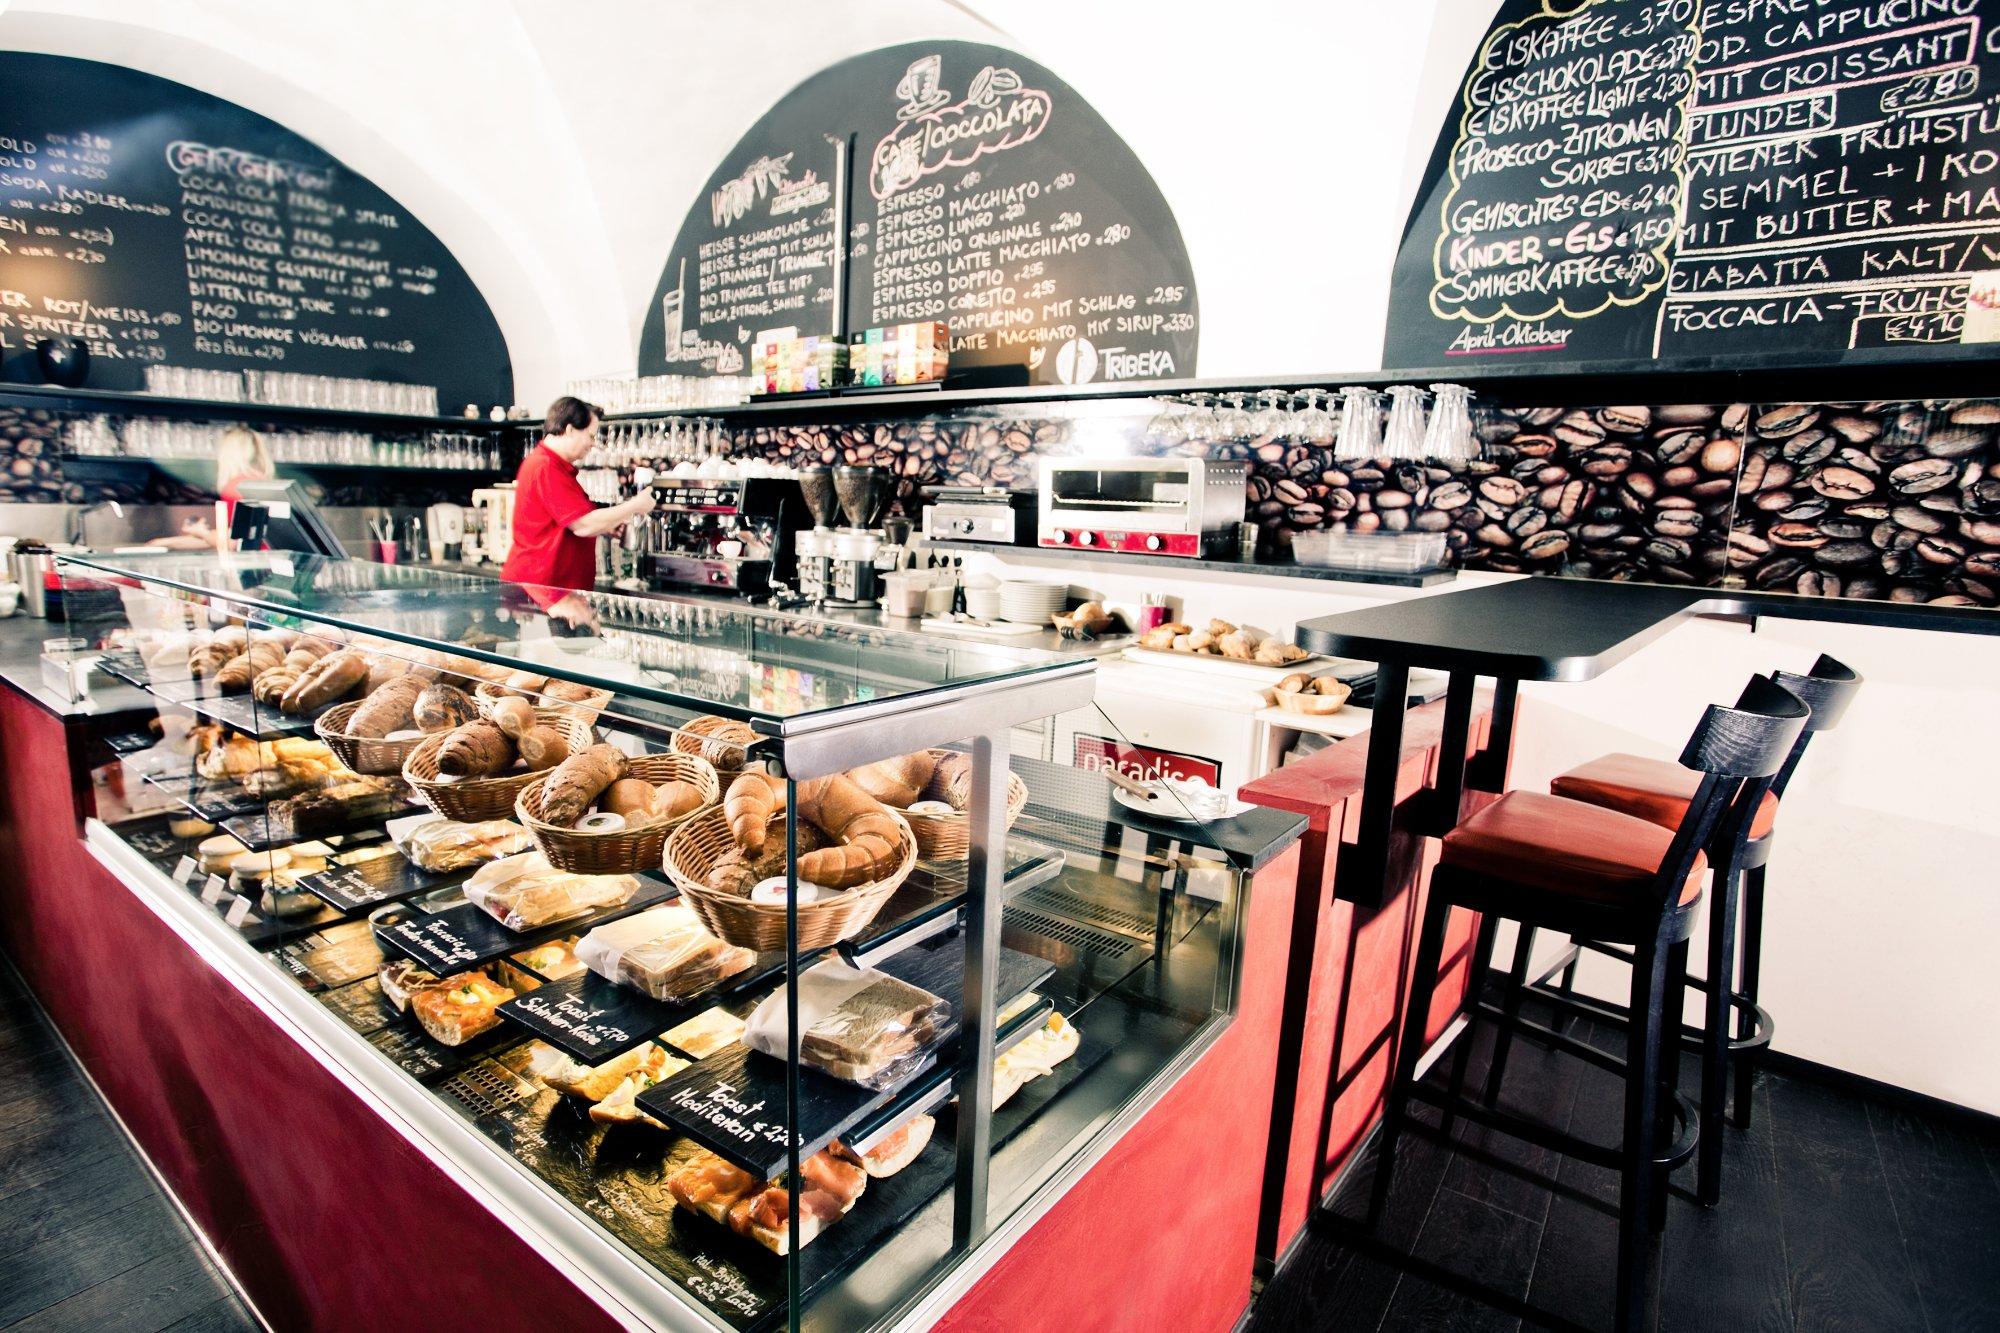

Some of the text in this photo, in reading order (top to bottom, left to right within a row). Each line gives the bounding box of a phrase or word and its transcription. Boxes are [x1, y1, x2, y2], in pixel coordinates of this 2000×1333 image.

[1485, 12, 1617, 71] EISKAFFEE
[1471, 43, 1656, 106] EISSCHOKOLADE
[1692, 70, 1751, 108] MIT
[1760, 28, 1970, 93] CROISSANT
[1467, 88, 1586, 136] EISKAFFEE
[1587, 73, 1650, 119] LIGHT
[1687, 97, 1832, 143] PLUNDER
[1540, 150, 1642, 188] SORBET
[1684, 138, 1818, 180] WIENER
[876, 205, 944, 235] ESPRESSO
[949, 181, 1040, 217] MACCHIATO
[877, 183, 945, 216] ESPRESSO
[1700, 166, 1859, 210] SEMMEL
[876, 224, 944, 253] ESPRESSO
[948, 211, 993, 237] LUNGO
[1452, 195, 1574, 236] GEMISCHTES
[1579, 188, 1622, 219] EIS
[1679, 218, 1734, 244] MIT
[1756, 198, 1894, 240] BUTTER
[699, 217, 811, 260] HEISSE SCHOKOLADE
[700, 253, 738, 276] HEISSE
[739, 245, 778, 266] SCHOKO
[780, 239, 801, 255] MIT
[873, 237, 963, 268] CAPPUCCINO
[968, 221, 1042, 249] ORIGINALE
[873, 260, 943, 288] ESPRESSO
[947, 251, 992, 274] LATTE
[999, 232, 1091, 264] MACCHIATO
[1437, 254, 1617, 302] SOMMERKAFFEE
[1669, 254, 1830, 292] CIABATTA
[872, 280, 944, 306] ESPRESSO
[948, 268, 1005, 293] DOPPIO
[1042, 299, 1073, 322] MIT
[1078, 293, 1136, 315] SCHLAG
[872, 299, 946, 324] ESPRESSO
[949, 332, 988, 352] LATTE
[997, 324, 1077, 349] MACCHIATO
[1087, 316, 1112, 337] MIT
[1116, 313, 1163, 336] SIRUP
[1029, 346, 1047, 370] by
[1098, 346, 1176, 381] TRIBEKA
[555, 992, 605, 1022] Toast
[706, 1080, 766, 1116] Toast
